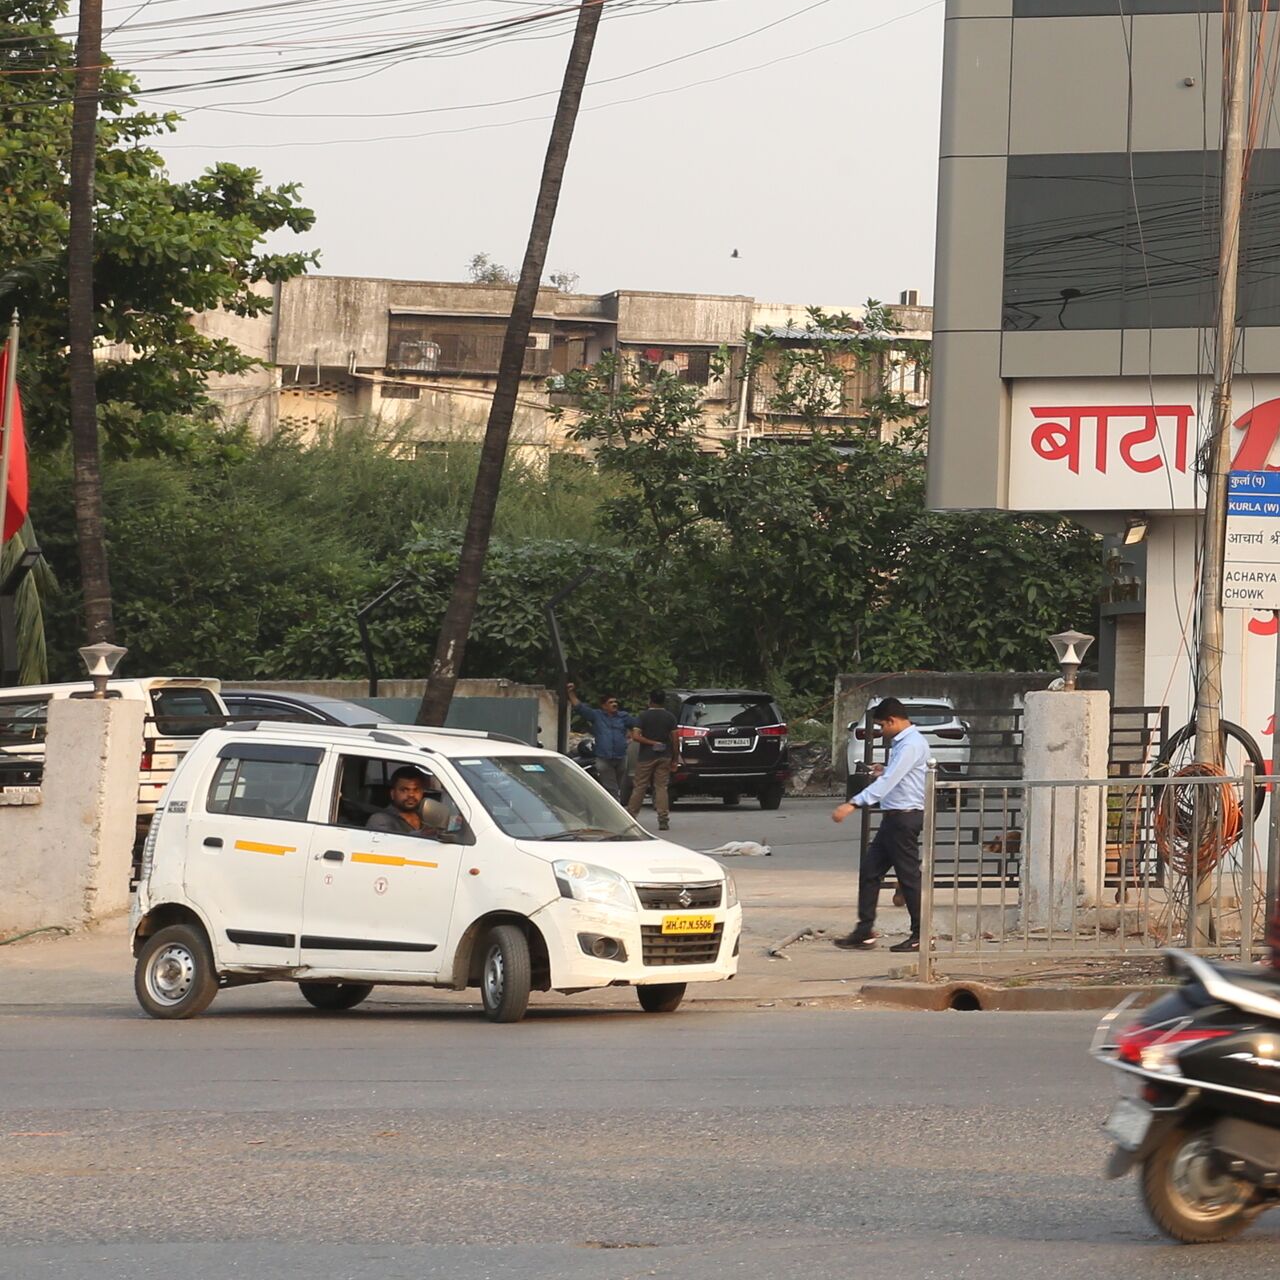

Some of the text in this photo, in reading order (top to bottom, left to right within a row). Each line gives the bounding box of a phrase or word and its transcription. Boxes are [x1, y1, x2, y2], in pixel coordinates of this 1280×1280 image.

[1030, 405, 1195, 475] बाटा
[1231, 474, 1250, 488] कुर्ला
[1228, 502, 1280, 514] KURLA (W)
[1228, 530, 1264, 544] आचार्य
[1225, 571, 1277, 583] ACHARYA
[1224, 588, 1264, 599] CHOWK
